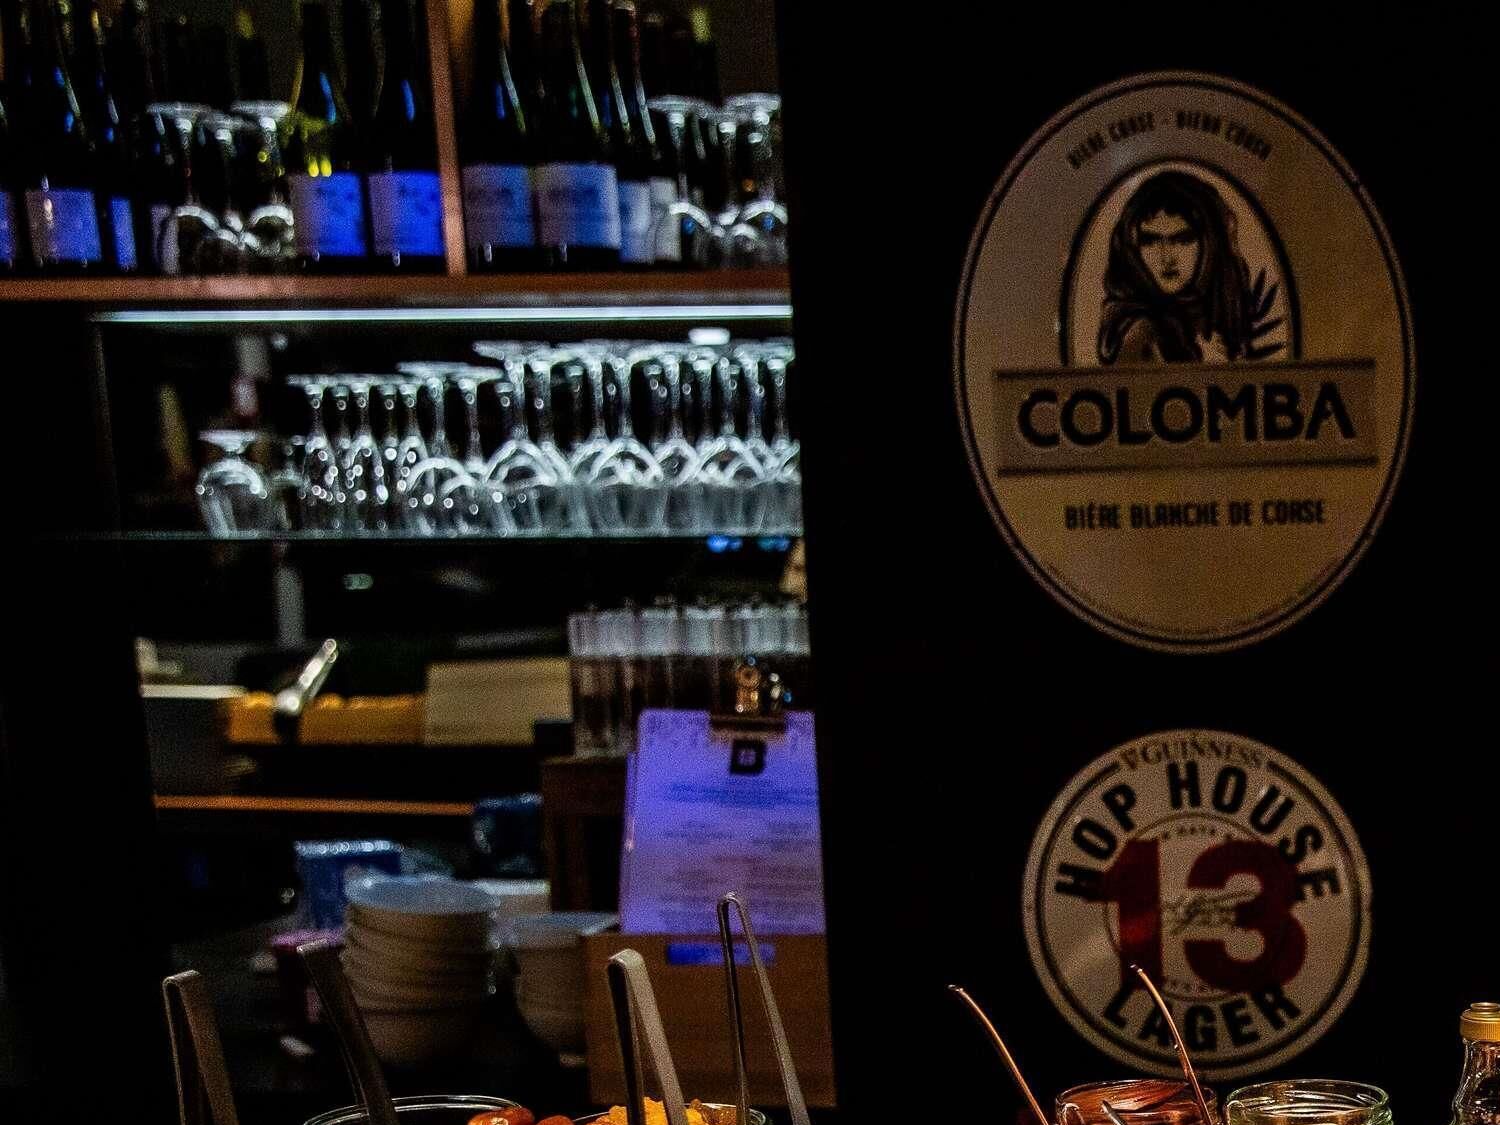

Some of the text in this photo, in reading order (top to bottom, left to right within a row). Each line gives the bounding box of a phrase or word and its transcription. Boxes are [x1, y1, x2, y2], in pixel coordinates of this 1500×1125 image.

[1019, 383, 1356, 446] COLOMBA
[1065, 500, 1325, 529] BIÈRE BLANCHE DE CORSE
[1054, 762, 1342, 906] HOP HOUSE
[1104, 838, 1308, 994] 13
[1102, 987, 1301, 1053] LAGER
